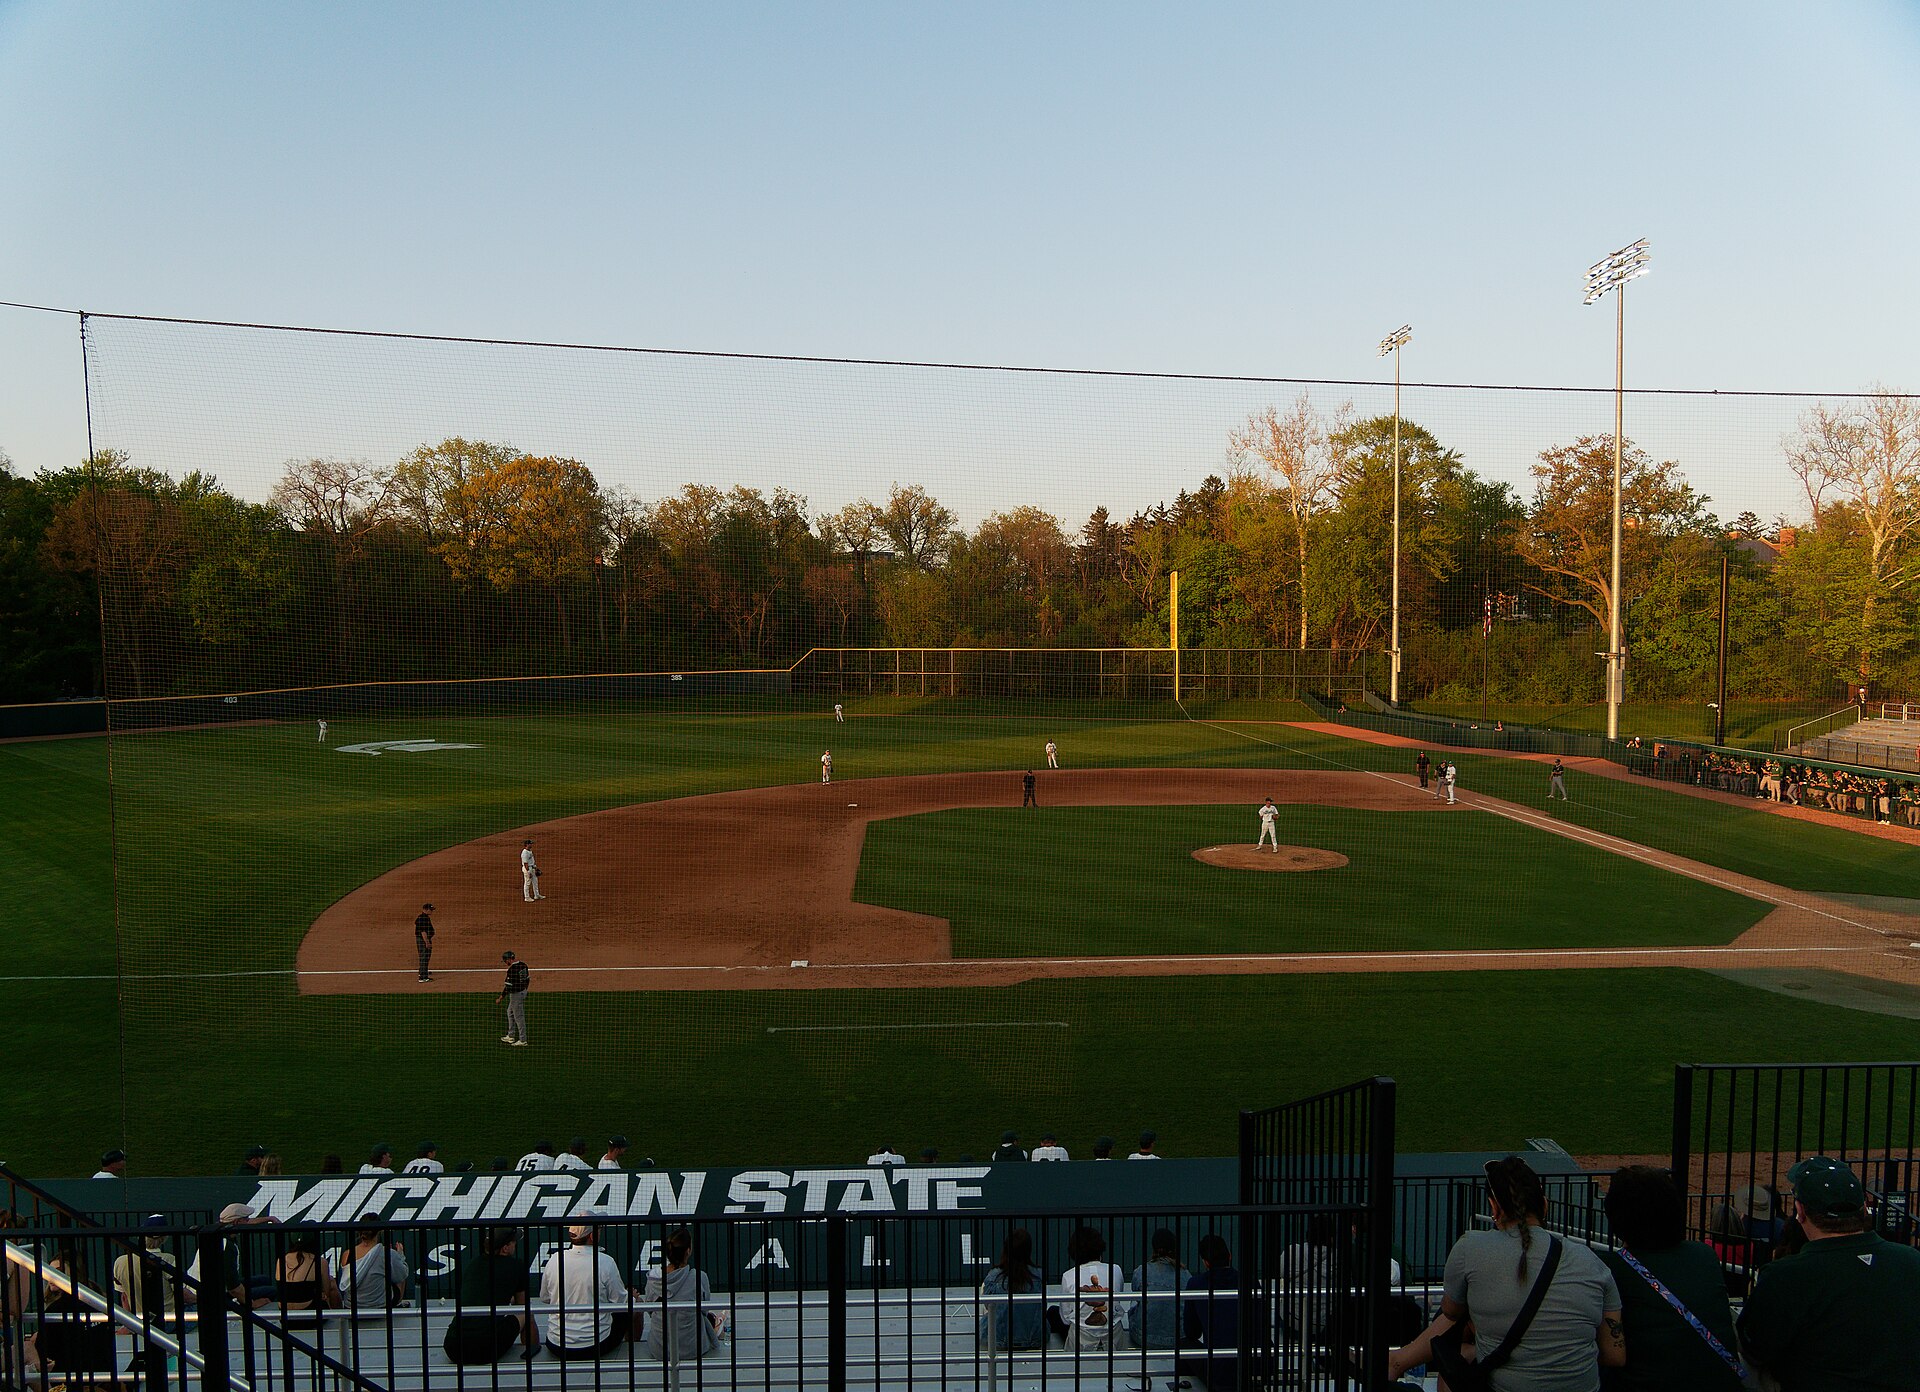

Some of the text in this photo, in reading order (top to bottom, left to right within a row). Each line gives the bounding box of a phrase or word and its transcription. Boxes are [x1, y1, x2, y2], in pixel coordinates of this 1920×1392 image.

[223, 696, 238, 704] 403
[246, 1166, 992, 1225] MICHIGAN STATE
